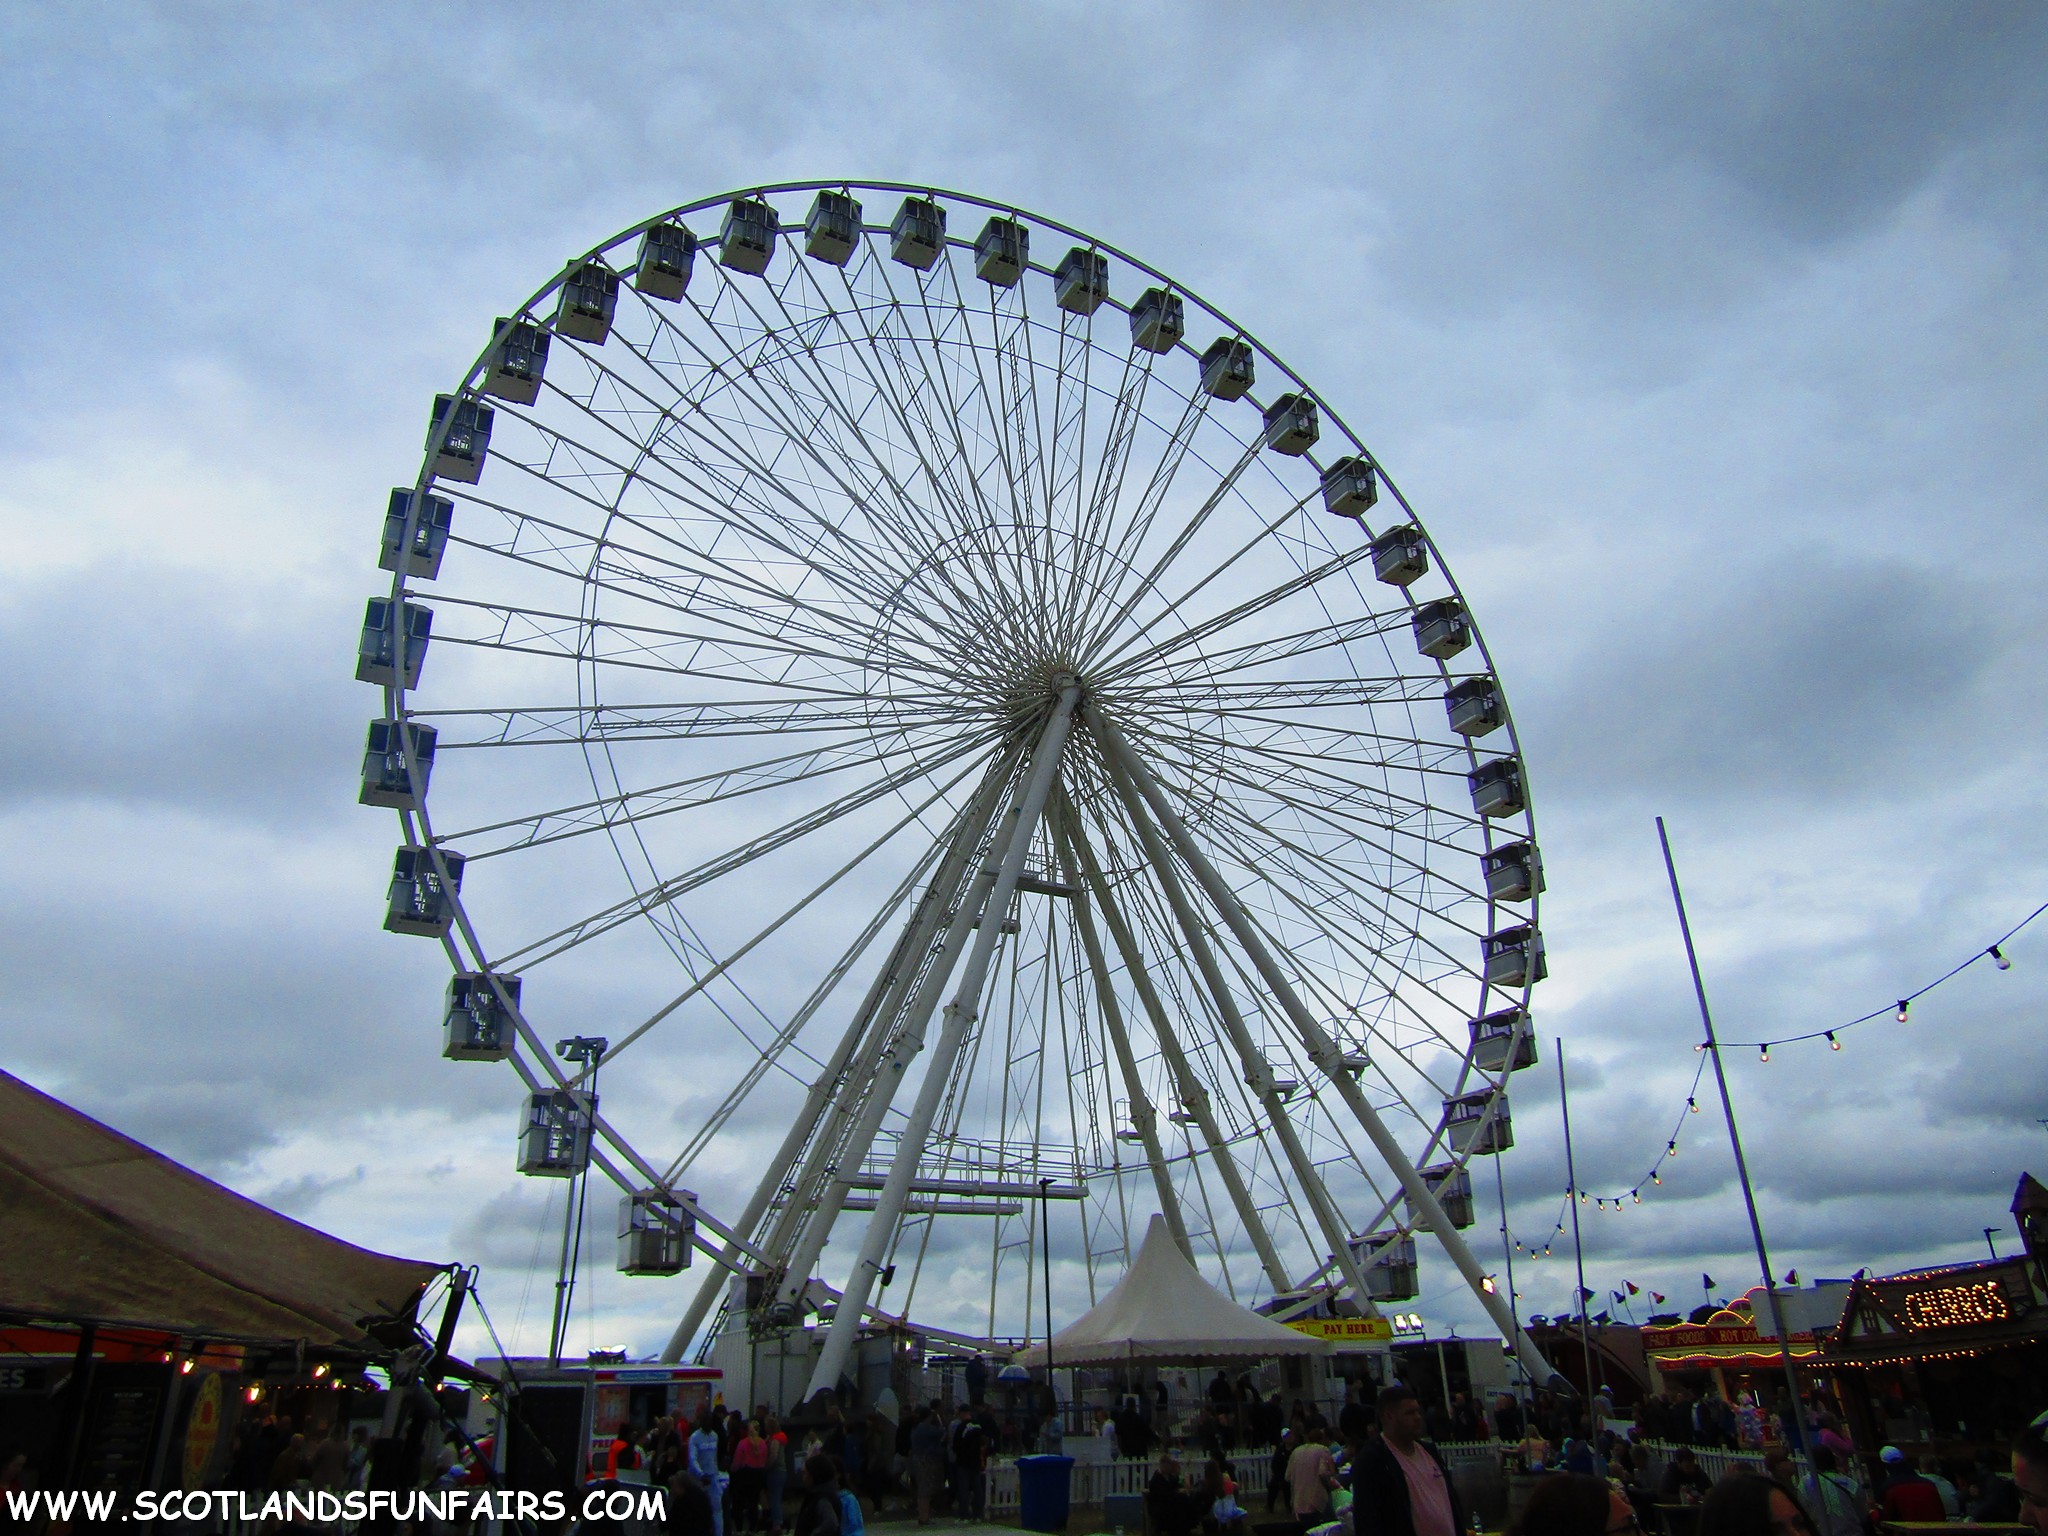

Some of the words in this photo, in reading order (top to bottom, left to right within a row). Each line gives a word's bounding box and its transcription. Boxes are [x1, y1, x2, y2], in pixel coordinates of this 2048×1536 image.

[1905, 1280, 2009, 1329] CHURROS
[1323, 1324, 1342, 1335] PAY
[1346, 1323, 1375, 1334] HERE
[1677, 1330, 1706, 1346] FOODS
[1719, 1329, 1738, 1343] HOT
